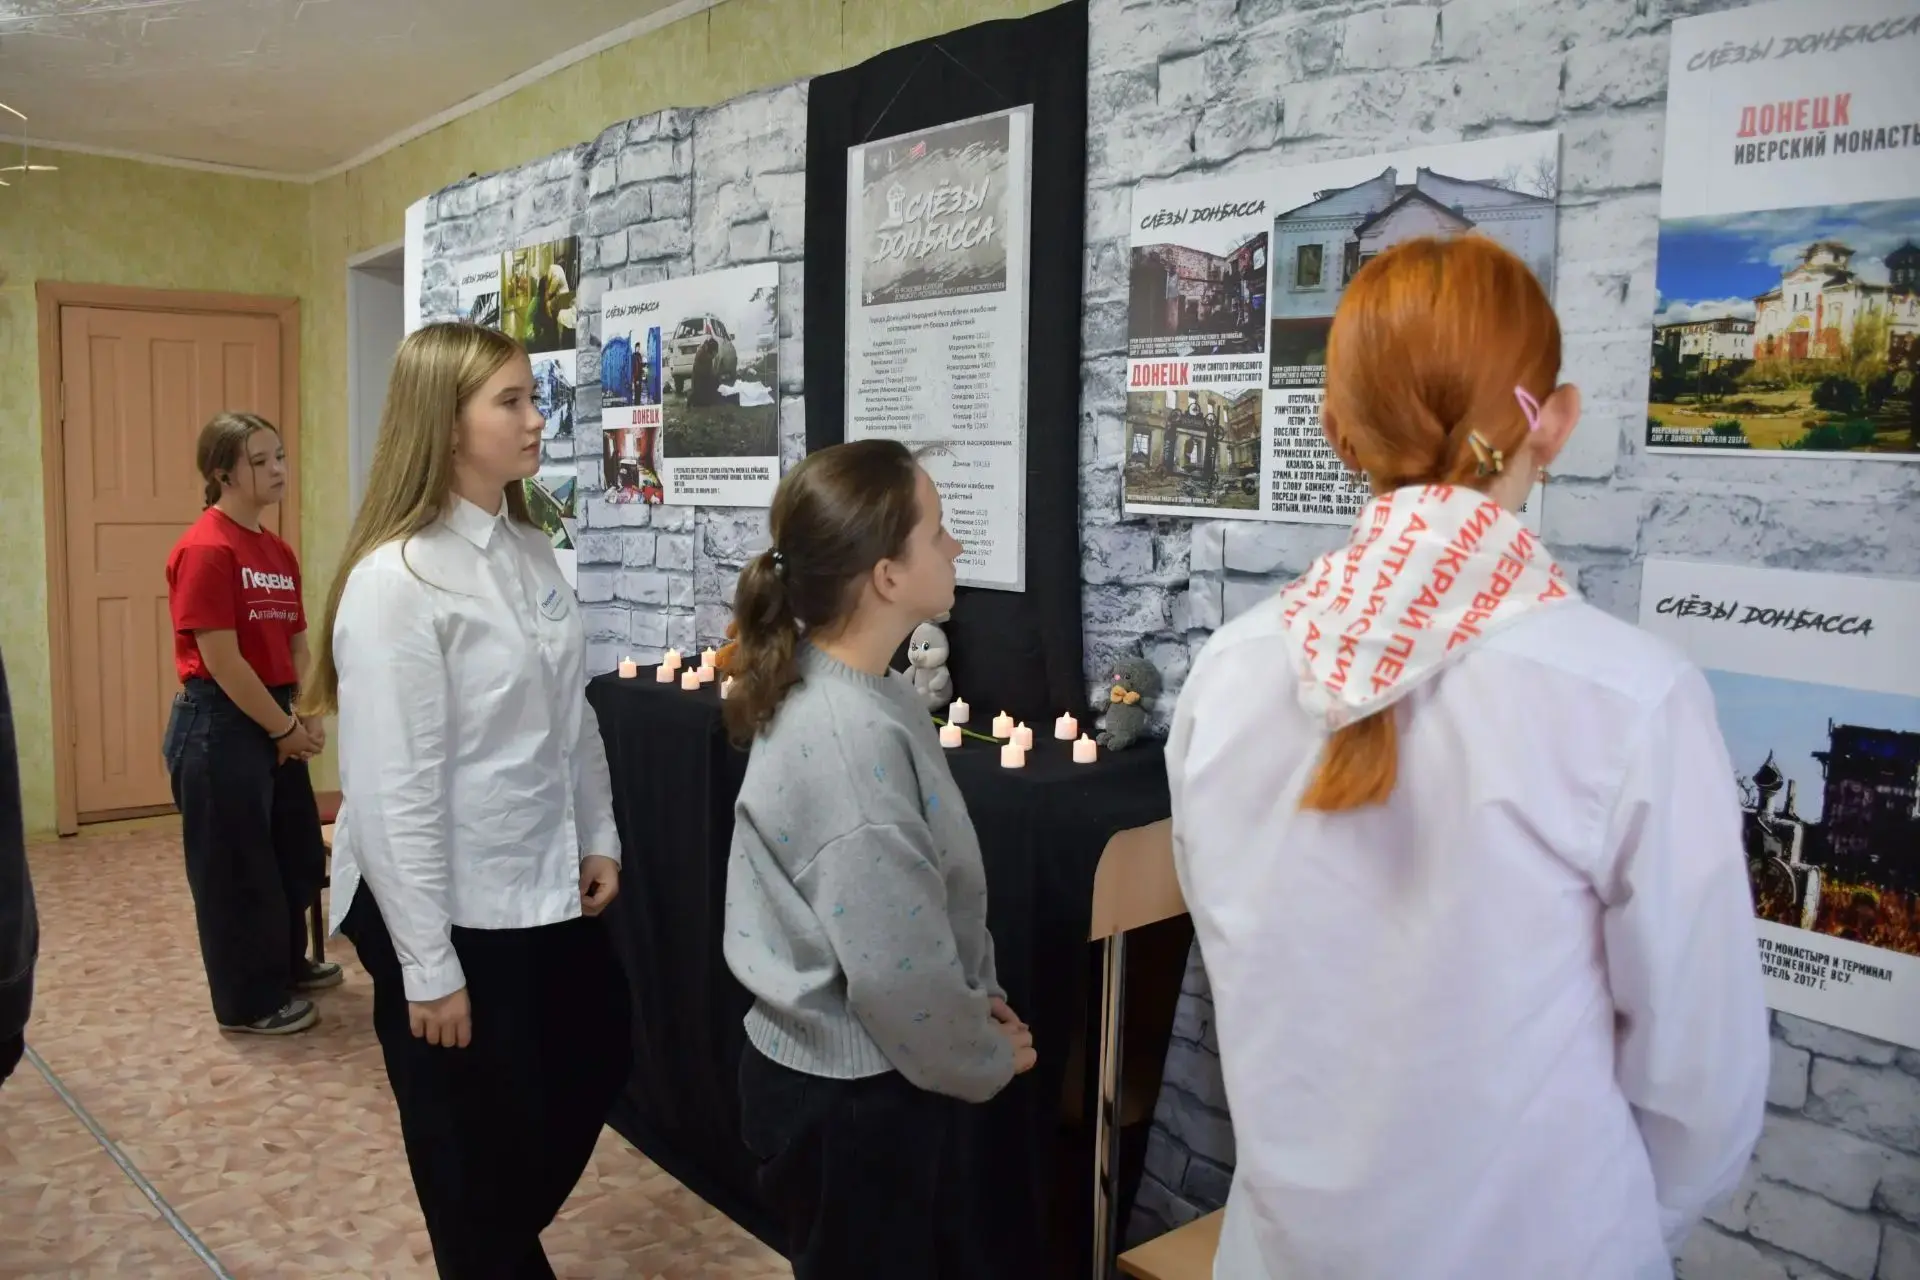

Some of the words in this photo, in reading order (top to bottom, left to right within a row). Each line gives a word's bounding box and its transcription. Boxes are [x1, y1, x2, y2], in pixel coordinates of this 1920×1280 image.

[1687, 36, 1774, 72] СЛЁЗЫ
[1773, 13, 1920, 60] ДОНБАССА
[1736, 92, 1852, 138] ДОНЕЦК
[1734, 130, 1827, 166] ИВЕРСКИЙ
[906, 175, 991, 224] СЛЁЗЫ
[1140, 207, 1189, 230] СЛЁЗЫ
[1189, 200, 1267, 225] ДОНБАССА
[873, 215, 998, 264] ДОНБАССА
[628, 301, 661, 315] ДОНБАССА
[1229, 361, 1263, 370] ПРАВЕДНОГО
[1131, 361, 1190, 387] ДОНЕЦК
[632, 409, 661, 426] ДОНЕЦК
[1274, 405, 1312, 415] УНИЧТОЖИТЬ
[1288, 416, 1306, 426] ЛЕТОМ
[1273, 427, 1300, 437] ПОСЕЛКЕ
[1303, 427, 1326, 437] ТРУДО
[1273, 438, 1291, 448] БЫЛА
[1273, 449, 1312, 459] УКРАИНСКИХ
[1313, 449, 1335, 460] КАРАТЕ
[1286, 460, 1315, 470] КАЗАЛОСЬ
[1300, 471, 1314, 480] ХОТЯ
[1315, 470, 1339, 481] РОДНОЙ
[1271, 481, 1280, 491] ПО
[1282, 481, 1302, 492] СЛОВУ
[1271, 491, 1298, 501] ПОСРЕДИ
[1302, 503, 1334, 515] НАЧАЛАСЬ
[1335, 505, 1357, 516] НОВАЯ
[1656, 594, 1738, 620] СЛЁЗЫ
[1739, 605, 1875, 637] ДОНБАССА
[1760, 950, 1827, 978] ЧТОЖЕННЫЕ
[1775, 942, 1830, 966] МОНАСТЫРЯ
[1832, 956, 1839, 968] И
[1842, 958, 1893, 982] ТЕРМИНАЛ
[1762, 963, 1790, 981] ПРЕЛЬ
[1793, 972, 1816, 988] 2017
